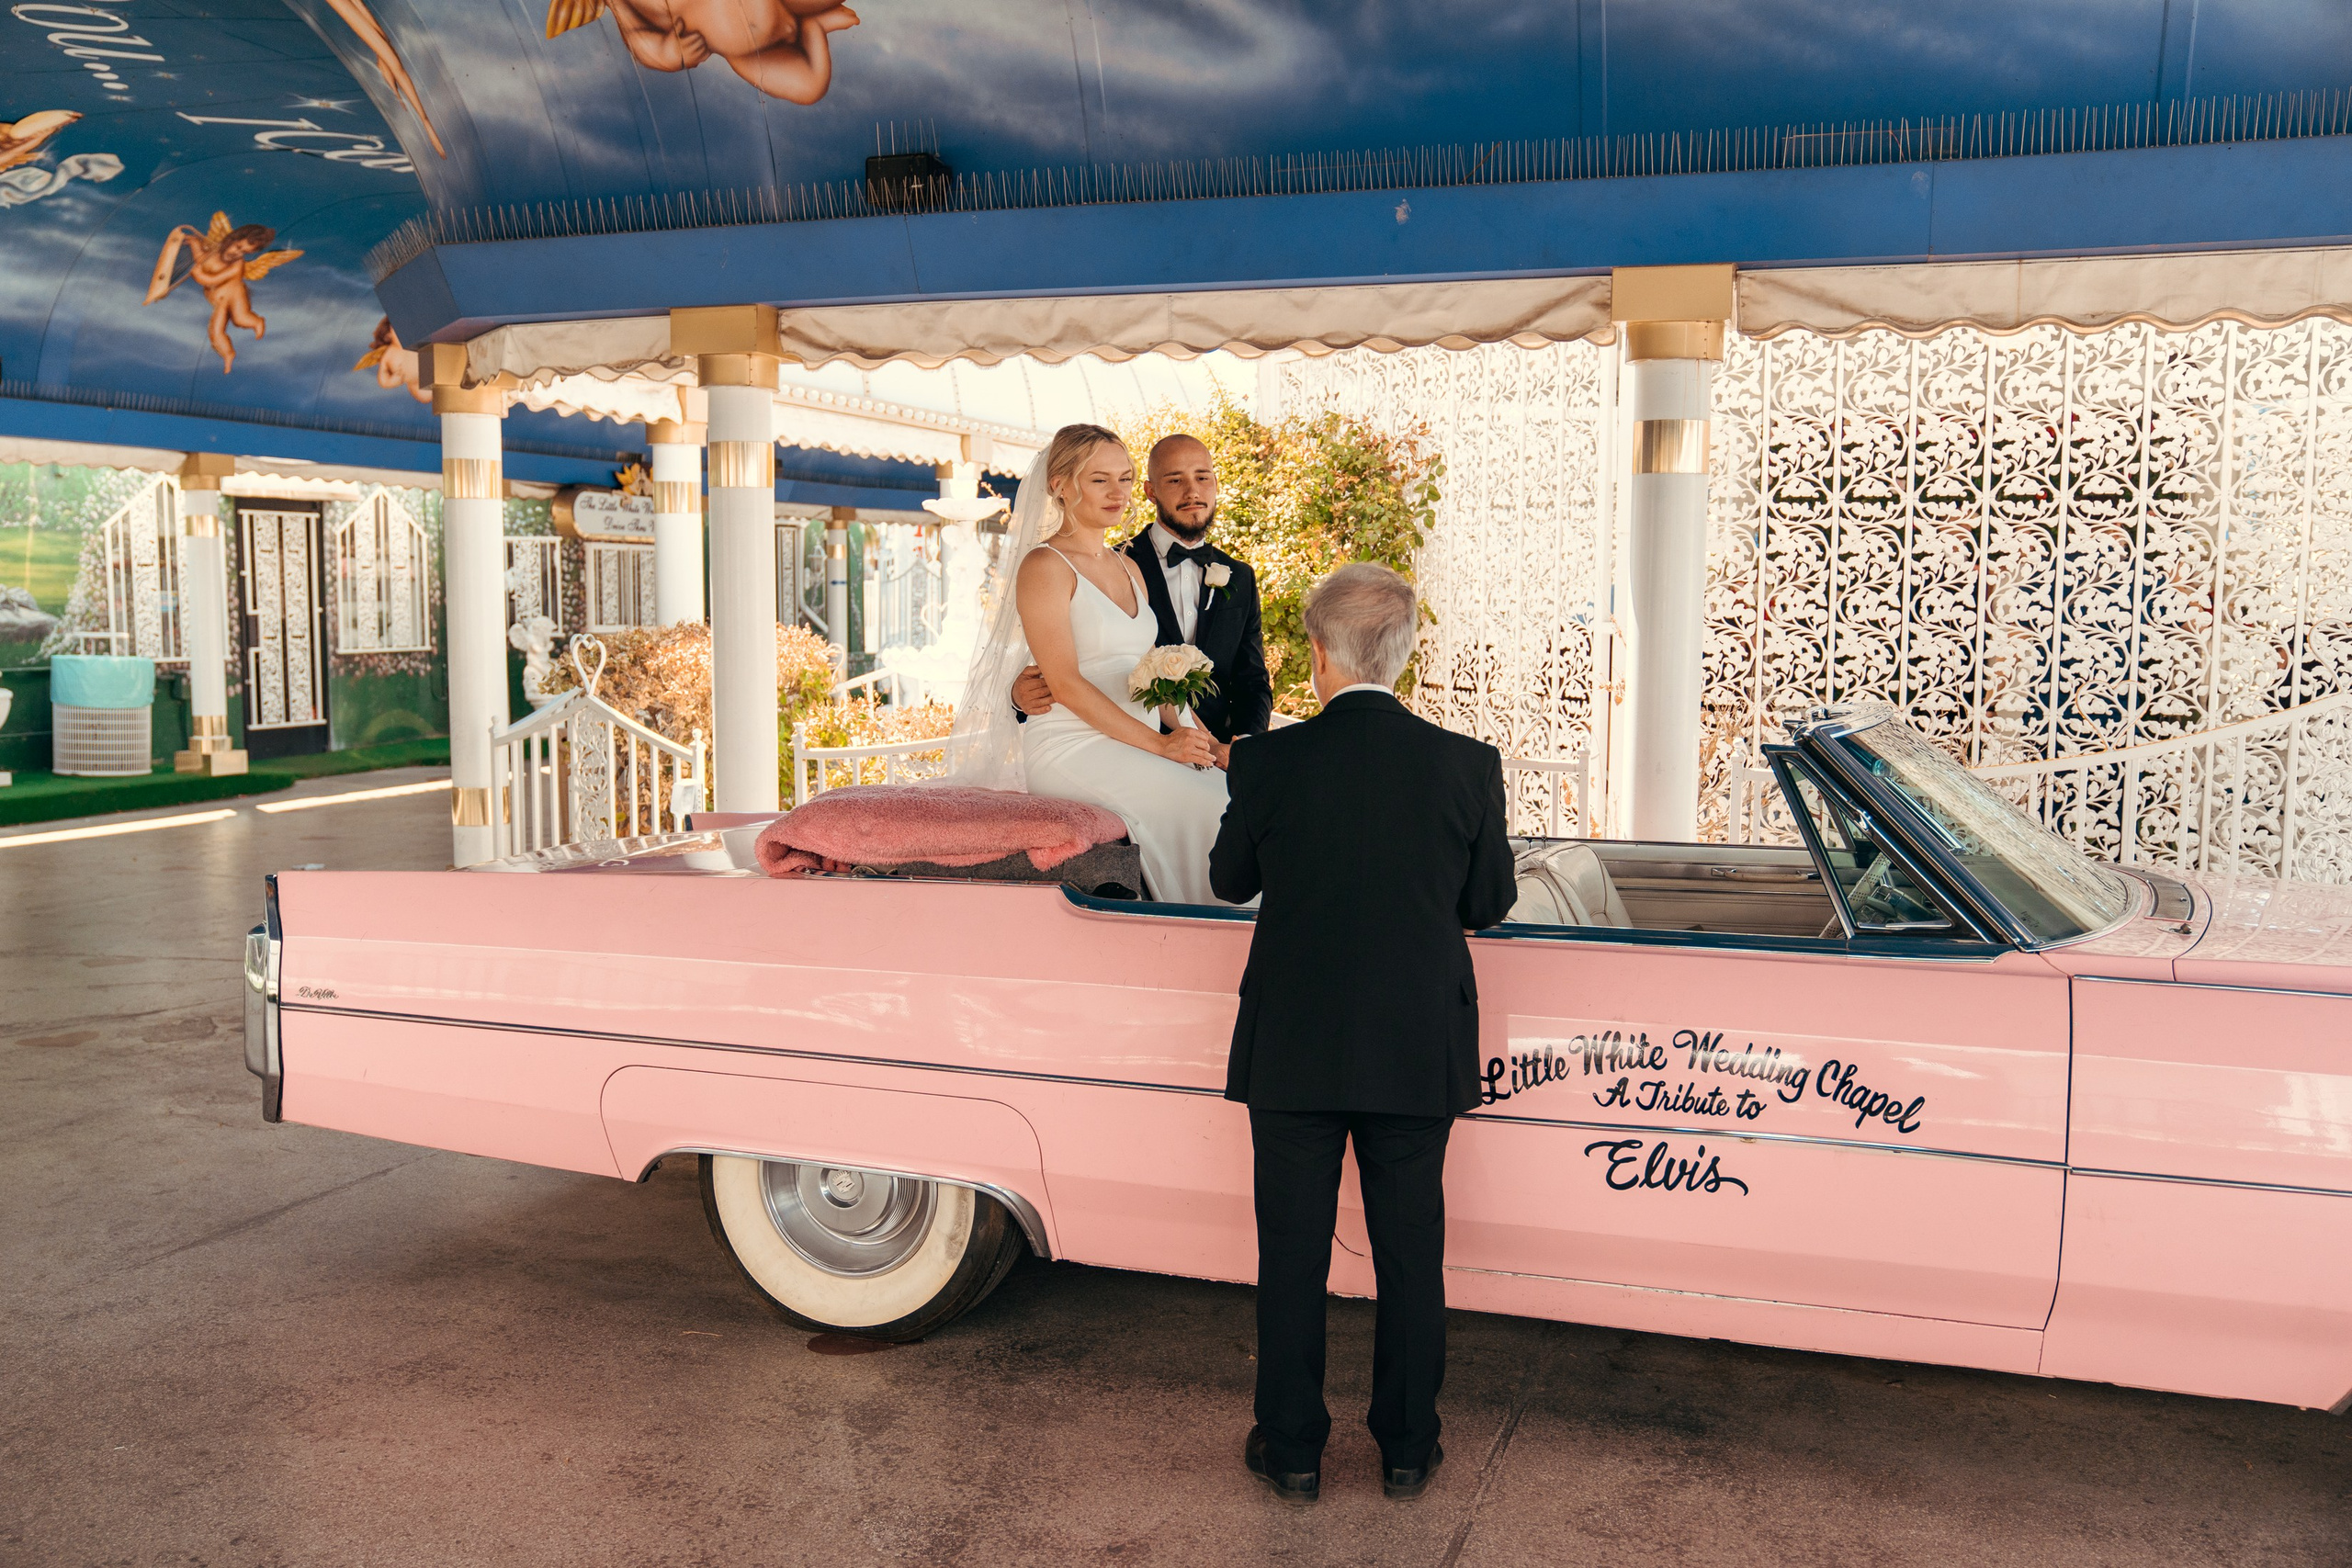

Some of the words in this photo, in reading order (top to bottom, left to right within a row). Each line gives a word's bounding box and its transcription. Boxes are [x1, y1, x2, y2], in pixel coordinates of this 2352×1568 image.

[580, 496, 595, 510] The
[599, 496, 617, 512] Little
[605, 516, 626, 530] Drive
[1481, 1044, 1570, 1105] Little
[1568, 1030, 1668, 1076] White
[1673, 1029, 1812, 1103] Wedding
[1816, 1059, 1927, 1134] Chapel
[1592, 1077, 1630, 1108] A
[1635, 1082, 1730, 1117] Tribute
[1736, 1089, 1767, 1120] to
[1584, 1139, 1749, 1196] Elvis
